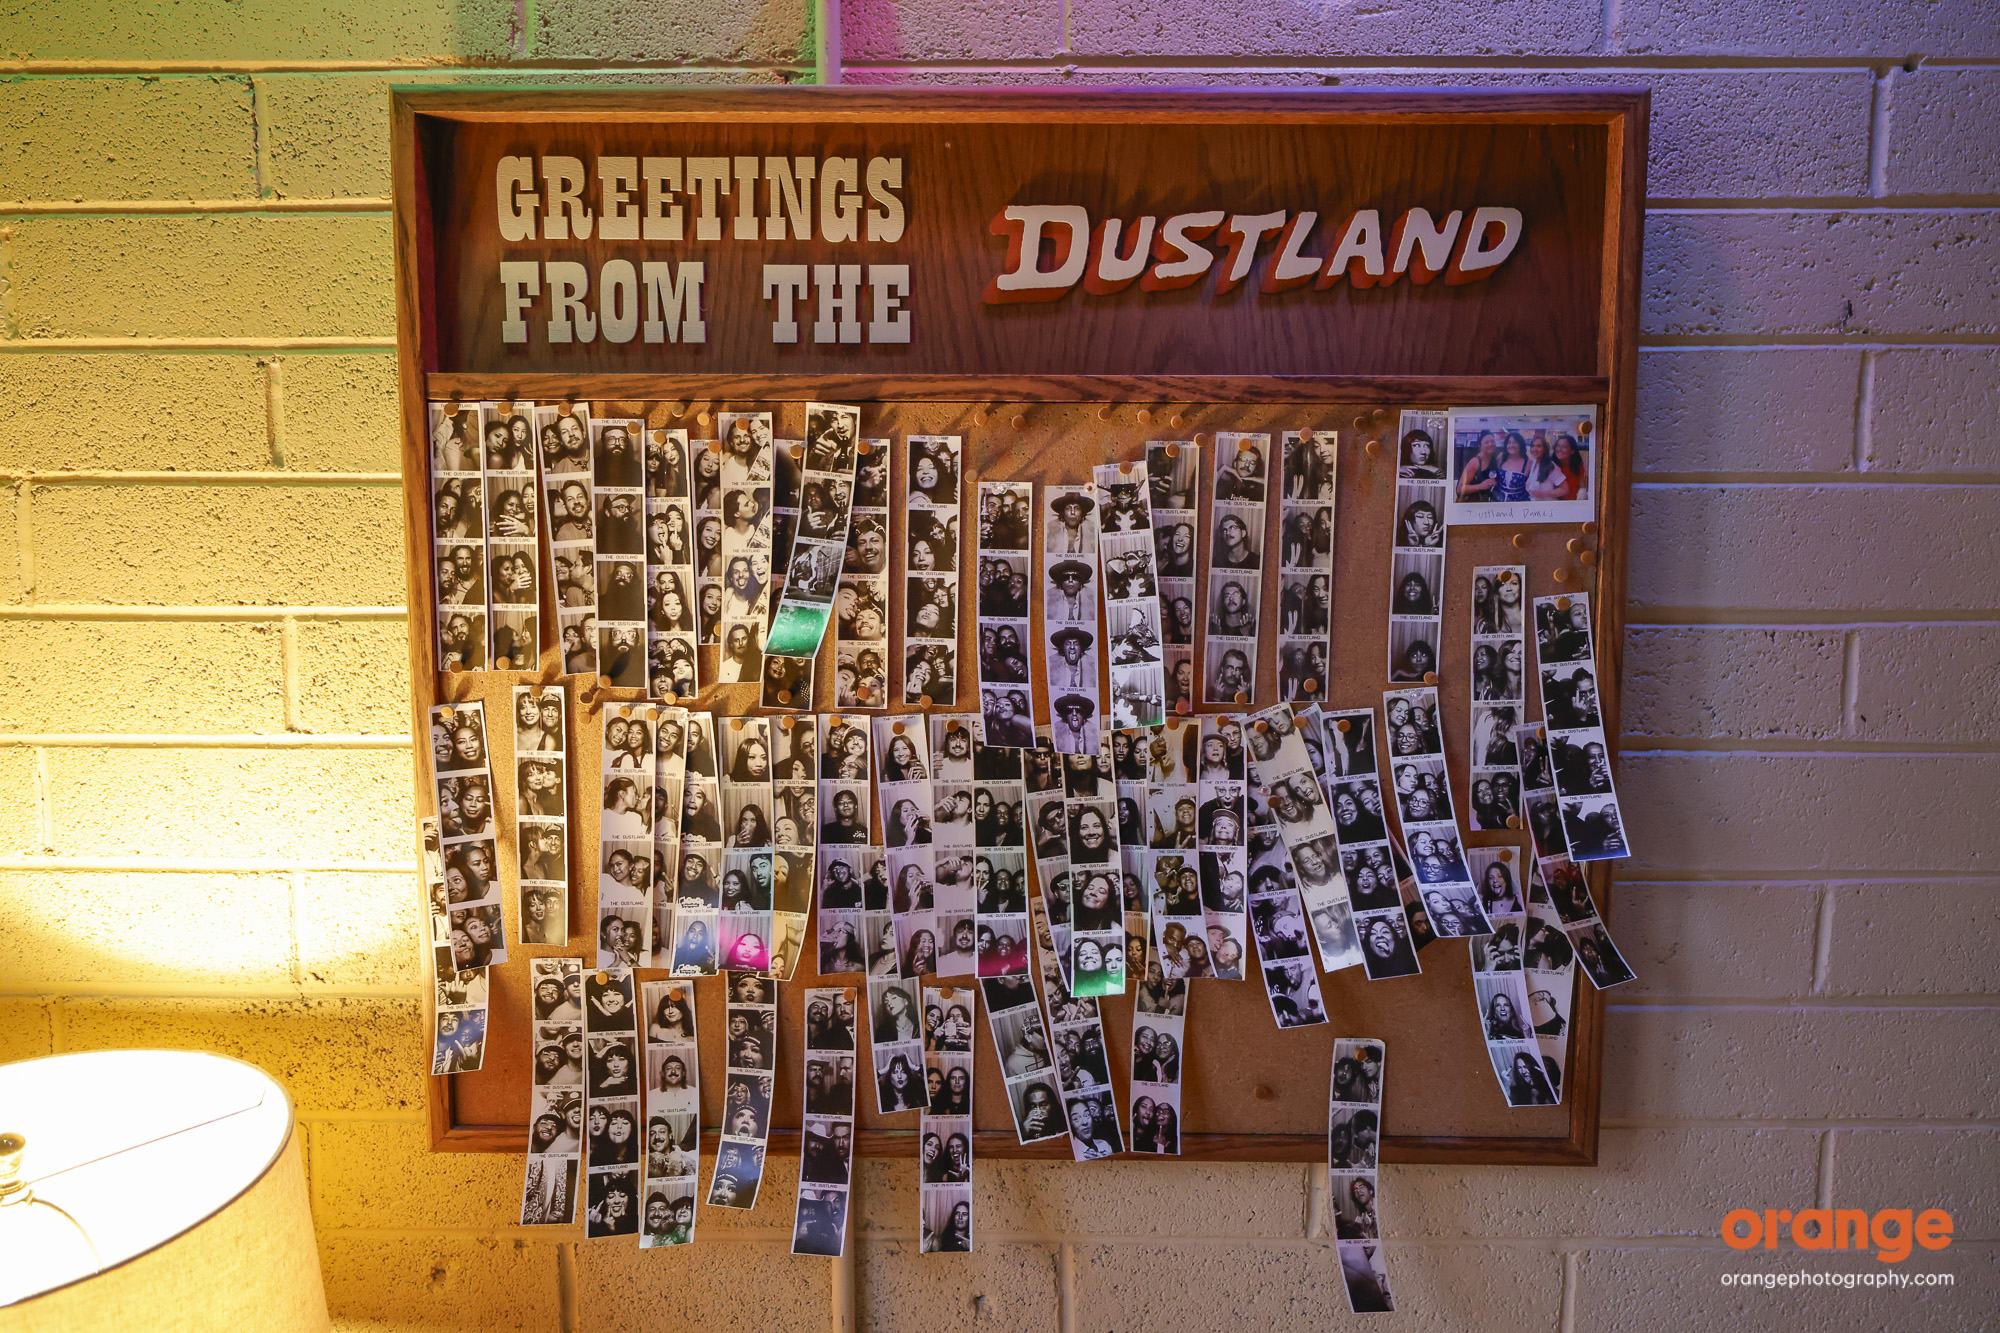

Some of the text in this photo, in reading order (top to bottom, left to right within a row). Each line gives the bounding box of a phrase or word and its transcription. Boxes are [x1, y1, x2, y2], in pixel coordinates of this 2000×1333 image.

[496, 155, 905, 243] GREETINGS
[990, 204, 1522, 296] DUSTLAND
[500, 259, 911, 344] FROM THE
[1259, 704, 1282, 716] DUSTLAND
[1282, 766, 1305, 778] DUSTLAND
[1305, 830, 1328, 840] DUSTLAND
